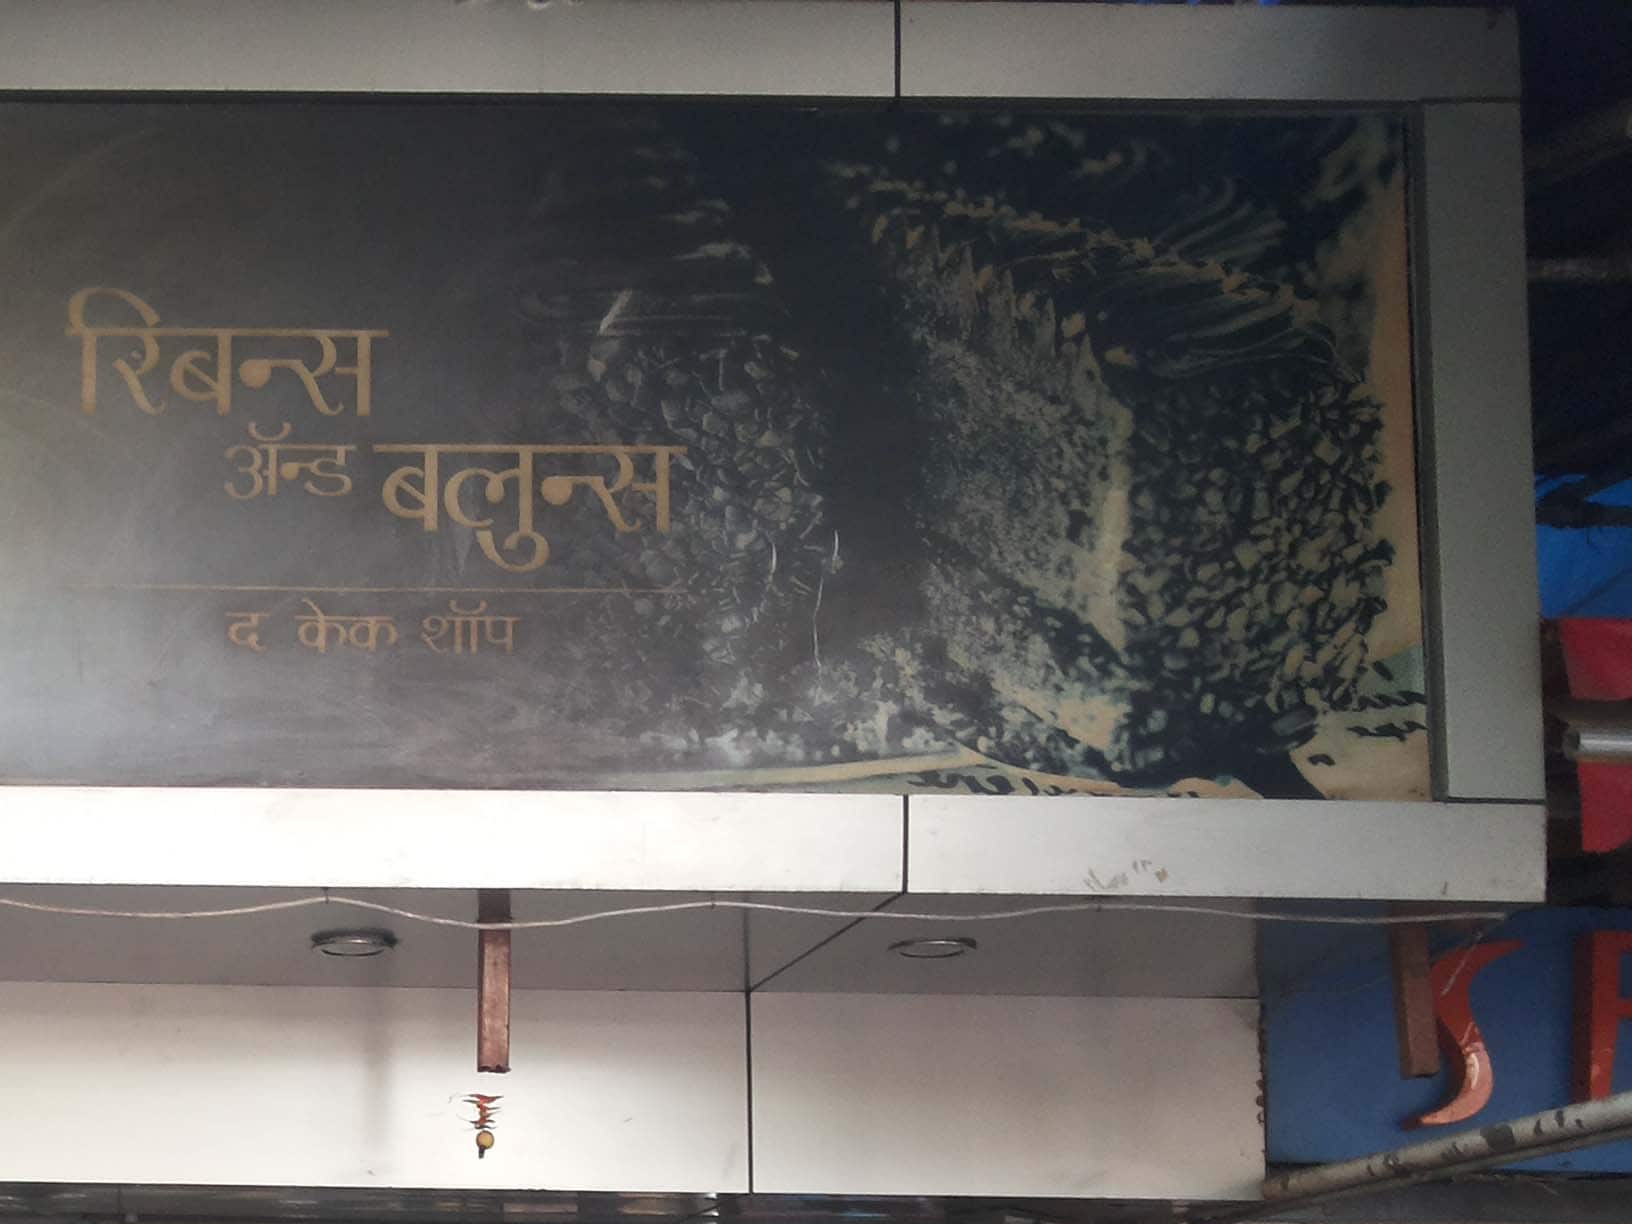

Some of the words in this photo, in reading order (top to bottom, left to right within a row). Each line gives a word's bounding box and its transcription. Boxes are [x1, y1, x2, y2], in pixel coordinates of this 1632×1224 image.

[67, 287, 390, 416] रिबन्स
[225, 610, 270, 652] द
[295, 597, 398, 655] केक
[420, 600, 521, 656] शॉप
